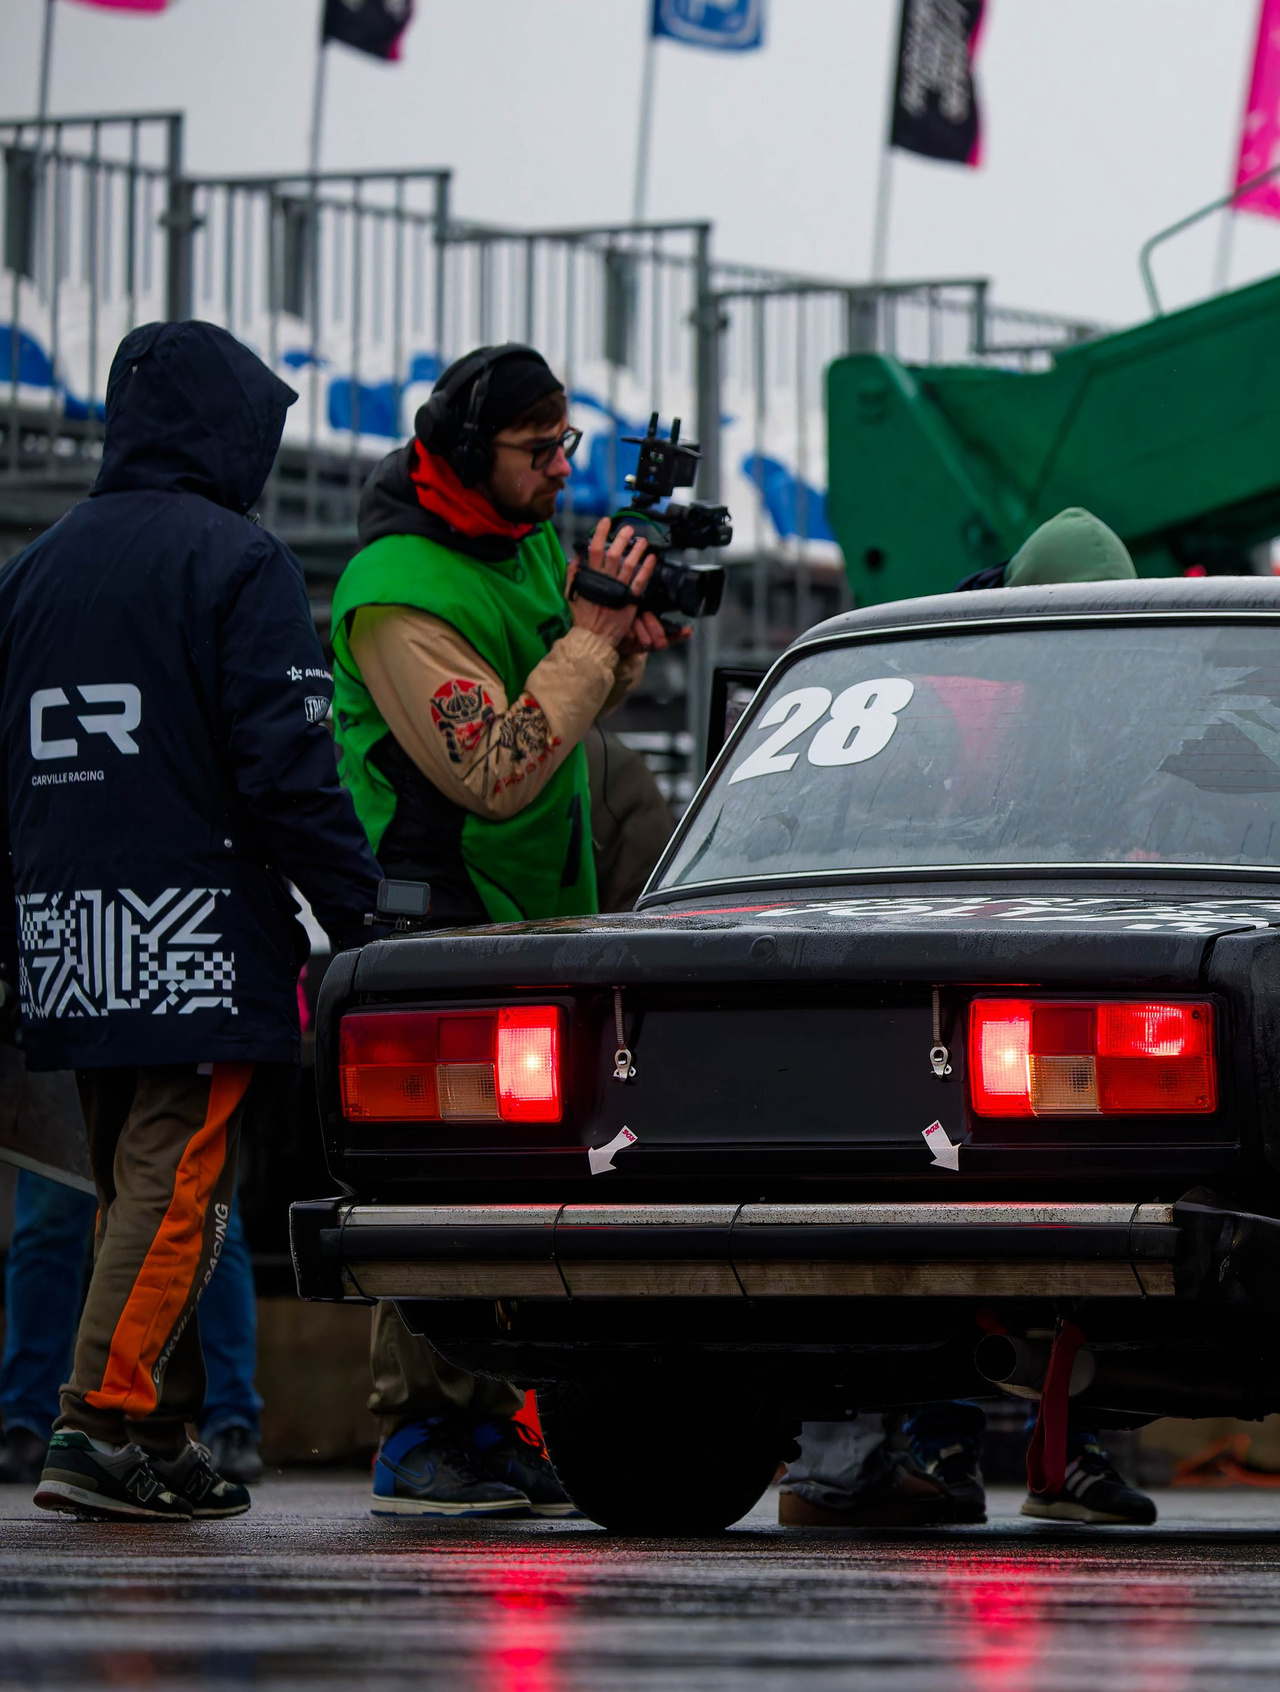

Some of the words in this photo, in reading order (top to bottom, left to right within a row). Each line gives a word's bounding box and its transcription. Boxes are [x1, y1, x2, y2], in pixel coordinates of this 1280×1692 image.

[30, 683, 142, 760] CR
[728, 677, 914, 786] 28
[31, 773, 68, 787] CARVILLE
[68, 770, 105, 783] RACING
[754, 904, 1079, 917] VOLT
